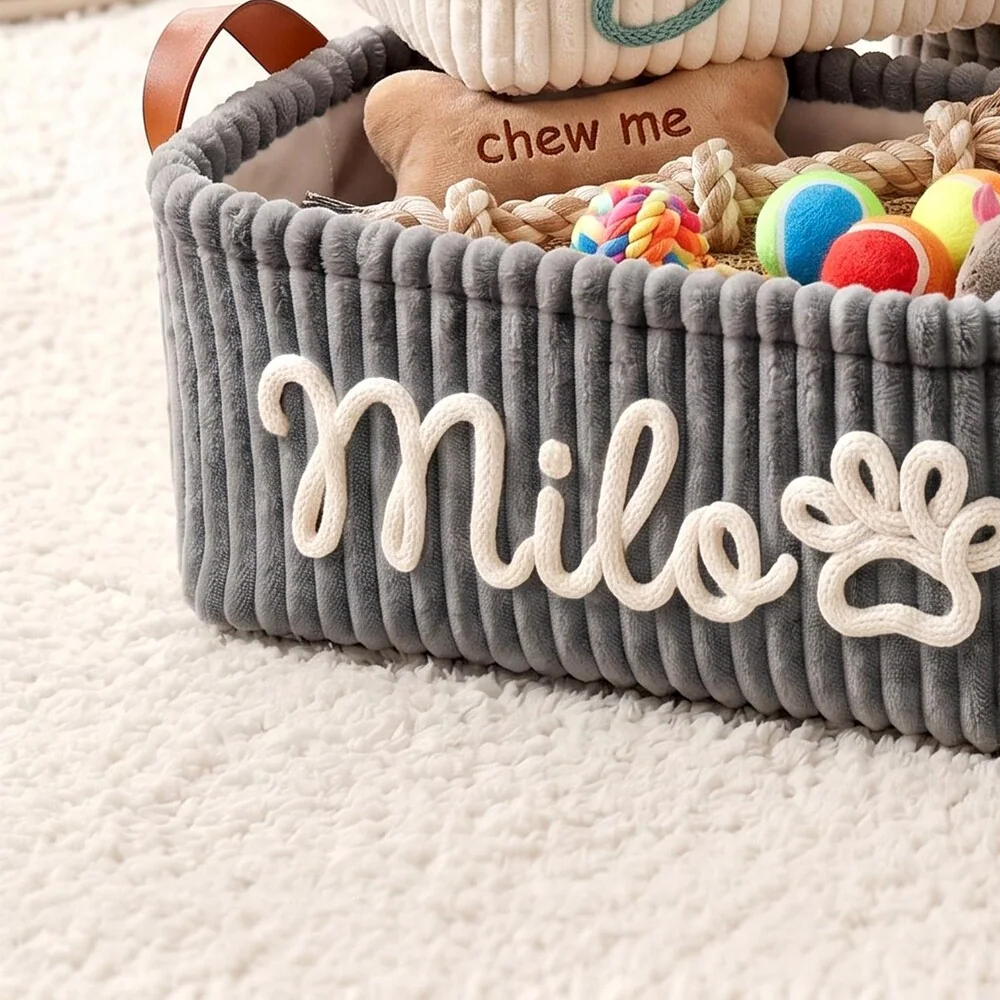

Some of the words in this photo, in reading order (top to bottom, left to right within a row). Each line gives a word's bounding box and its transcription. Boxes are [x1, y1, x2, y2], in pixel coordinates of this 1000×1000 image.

[477, 119, 599, 164] chew
[620, 107, 692, 146] me
[257, 353, 798, 623] Milo
